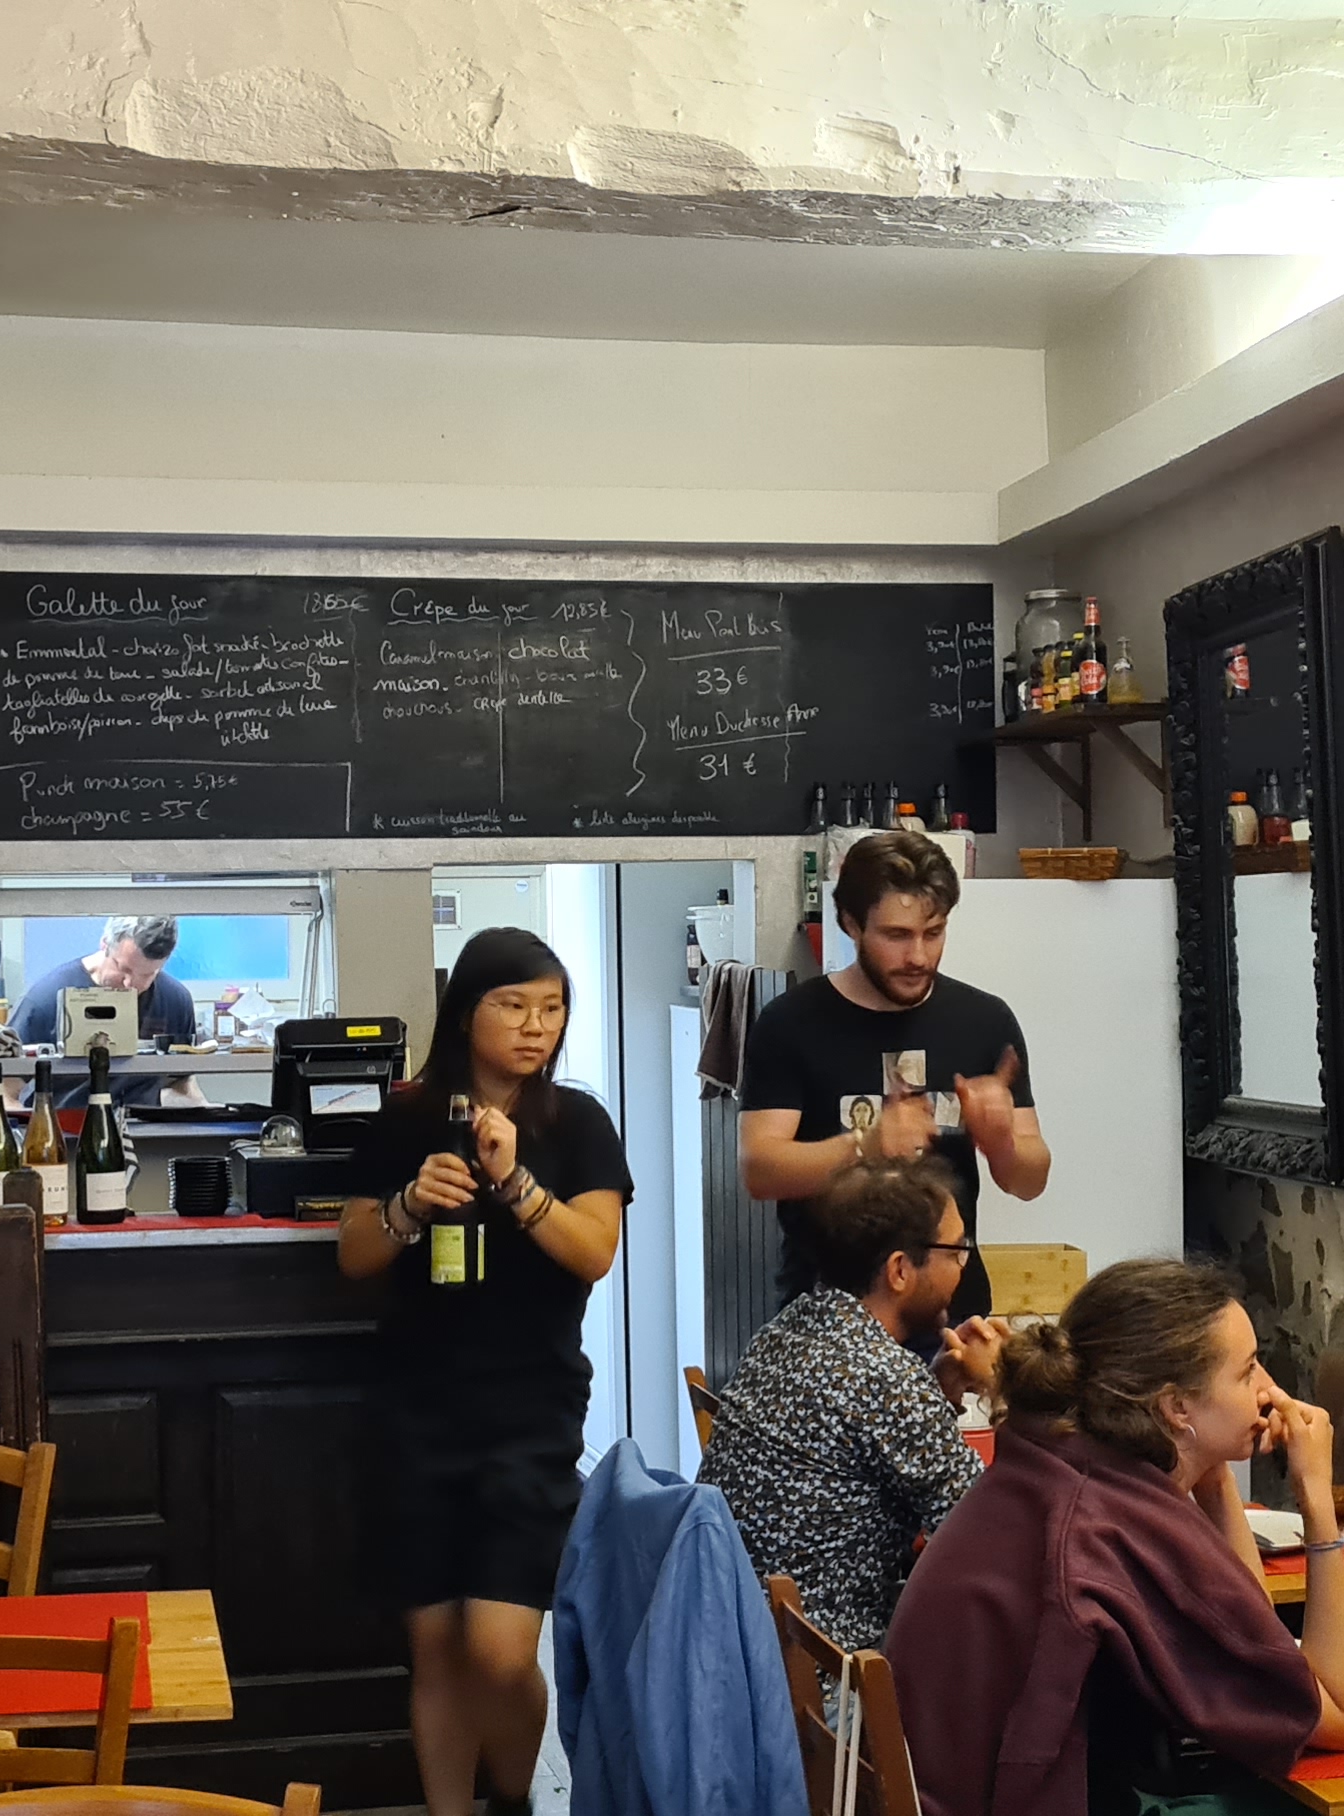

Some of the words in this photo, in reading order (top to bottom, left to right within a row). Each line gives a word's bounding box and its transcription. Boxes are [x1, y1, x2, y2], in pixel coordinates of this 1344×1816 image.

[26, 584, 124, 616] Galette
[129, 588, 162, 614] du
[169, 594, 207, 626] jour
[468, 595, 490, 614] du
[501, 603, 530, 627] jour
[662, 610, 701, 643] Menu
[16, 636, 108, 659] Emmental
[508, 635, 590, 661] chocolat
[2, 669, 21, 687] de
[696, 666, 733, 694] 33
[737, 665, 749, 685] €
[93, 687, 114, 703] de
[188, 709, 210, 724] de
[214, 708, 272, 730] pomme
[276, 699, 296, 718] de
[667, 714, 708, 741] Menu
[715, 708, 781, 735] Duchesse
[699, 753, 729, 780] 31
[742, 752, 757, 775] €
[19, 771, 75, 802] Punch
[84, 776, 166, 791] maison
[21, 806, 131, 836] champagne
[158, 800, 193, 819] 55
[508, 812, 527, 823] au
